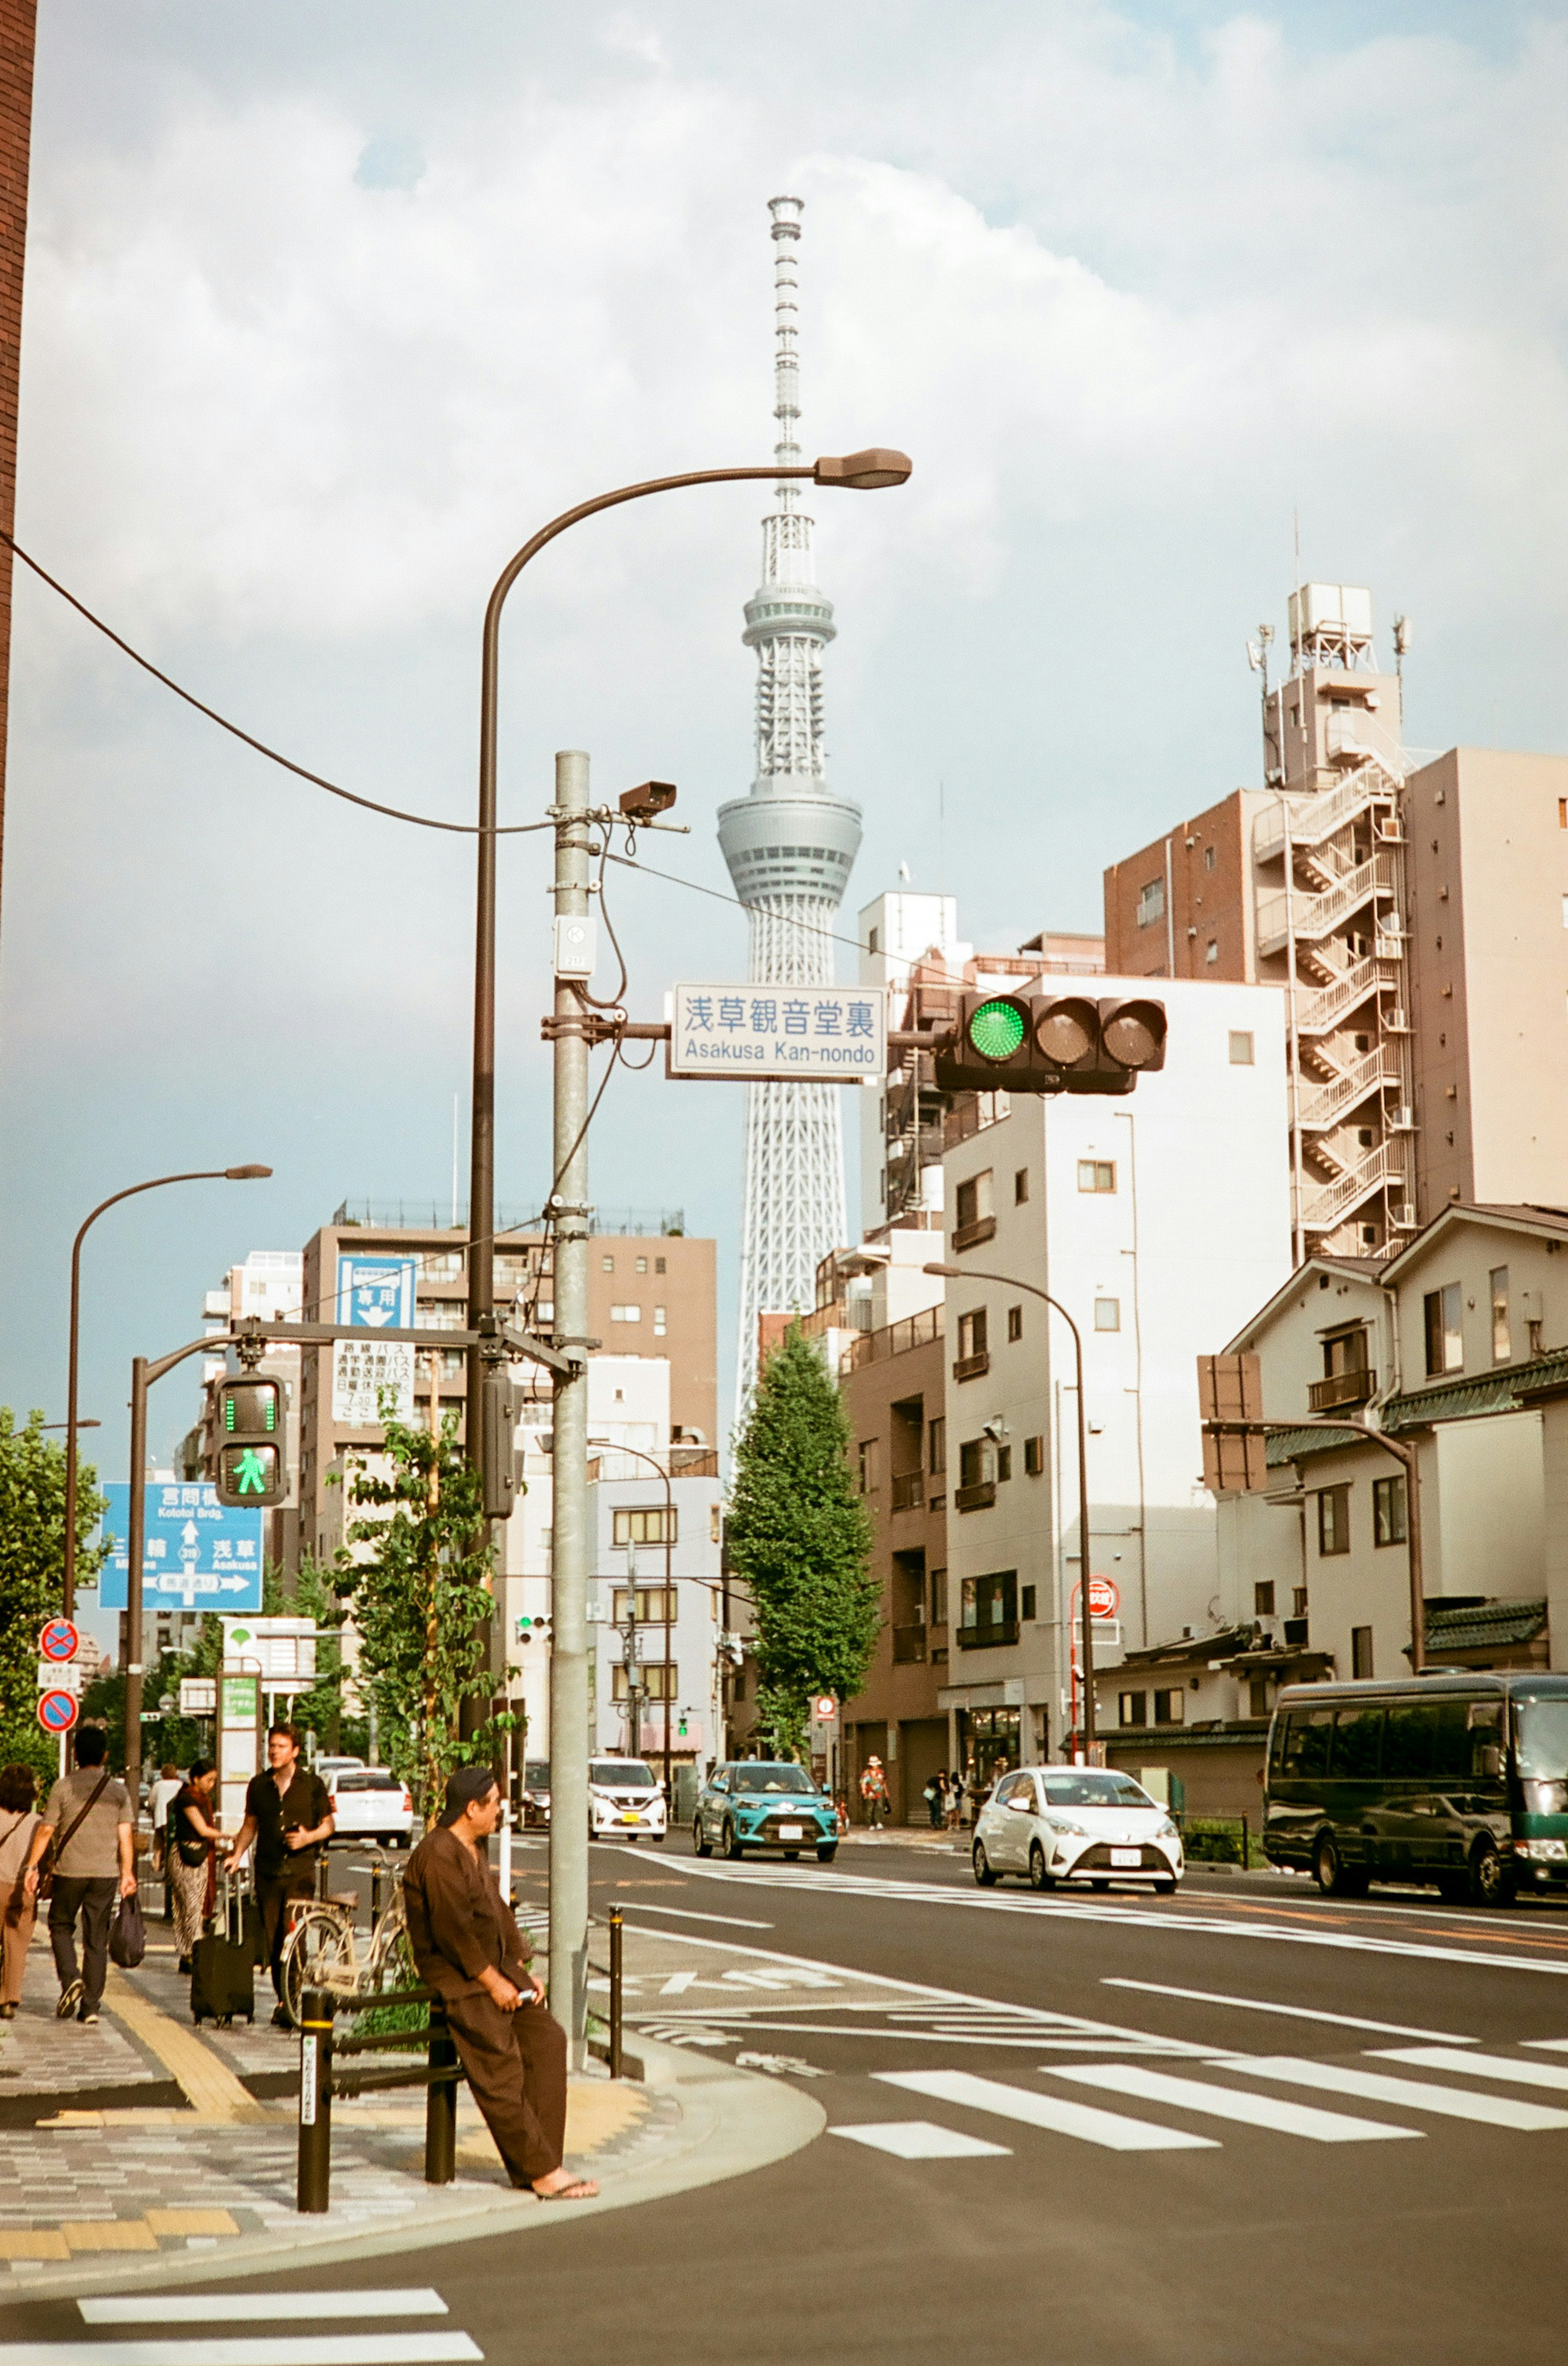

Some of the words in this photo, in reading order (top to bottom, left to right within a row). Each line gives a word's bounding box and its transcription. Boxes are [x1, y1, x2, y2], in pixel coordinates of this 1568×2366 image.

[685, 996, 874, 1038] 浅草観音堂裏
[685, 1038, 764, 1059] Asakusa
[775, 1041, 875, 1064] Kan-nondo
[357, 1289, 396, 1307] 専用
[344, 1343, 404, 1354] 路線バス
[213, 1539, 255, 1558] 浅草
[212, 1559, 257, 1570] Asakusa
